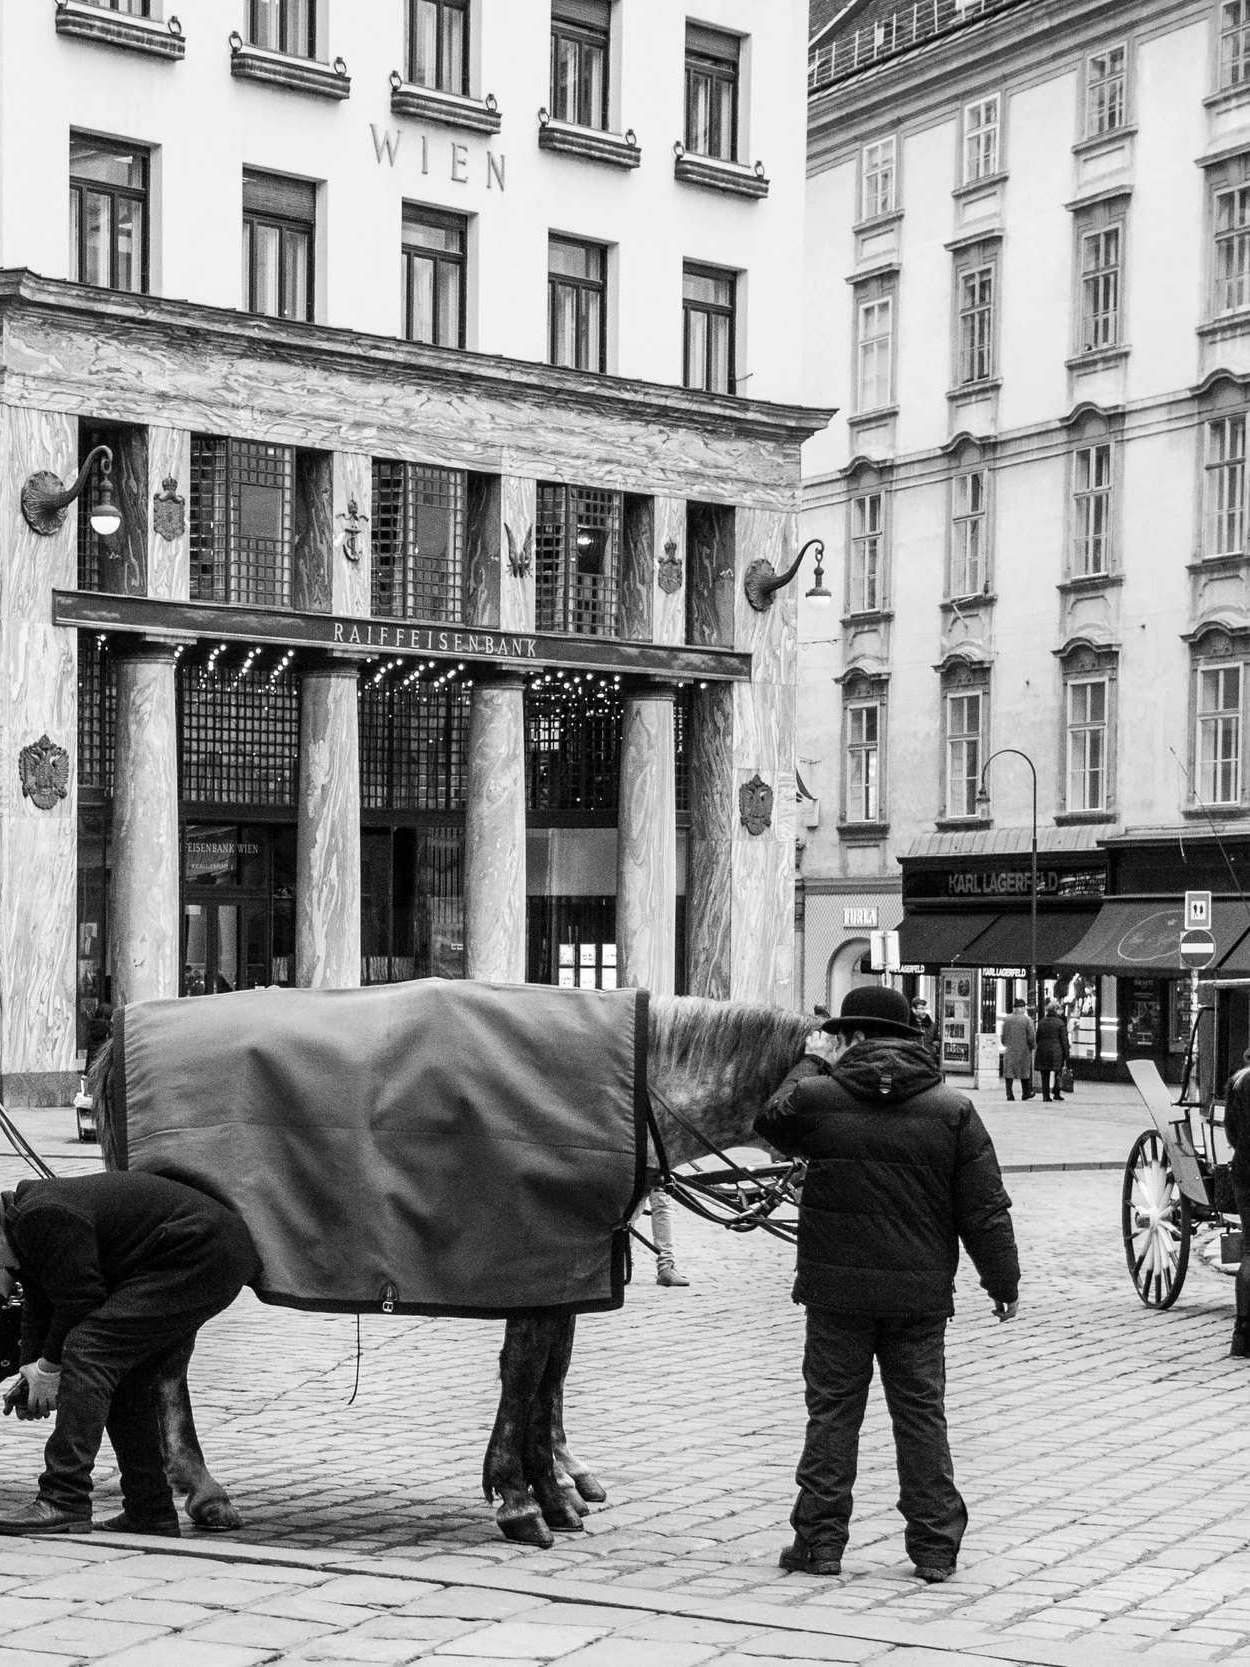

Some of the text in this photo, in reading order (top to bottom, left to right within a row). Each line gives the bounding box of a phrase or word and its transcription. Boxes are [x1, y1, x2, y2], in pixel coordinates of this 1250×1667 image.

[369, 123, 505, 192] WIEN
[333, 622, 536, 658] RAIFFEISENBANK
[949, 873, 981, 893] KARL
[982, 967, 1026, 977] KARL LAGERFELD
